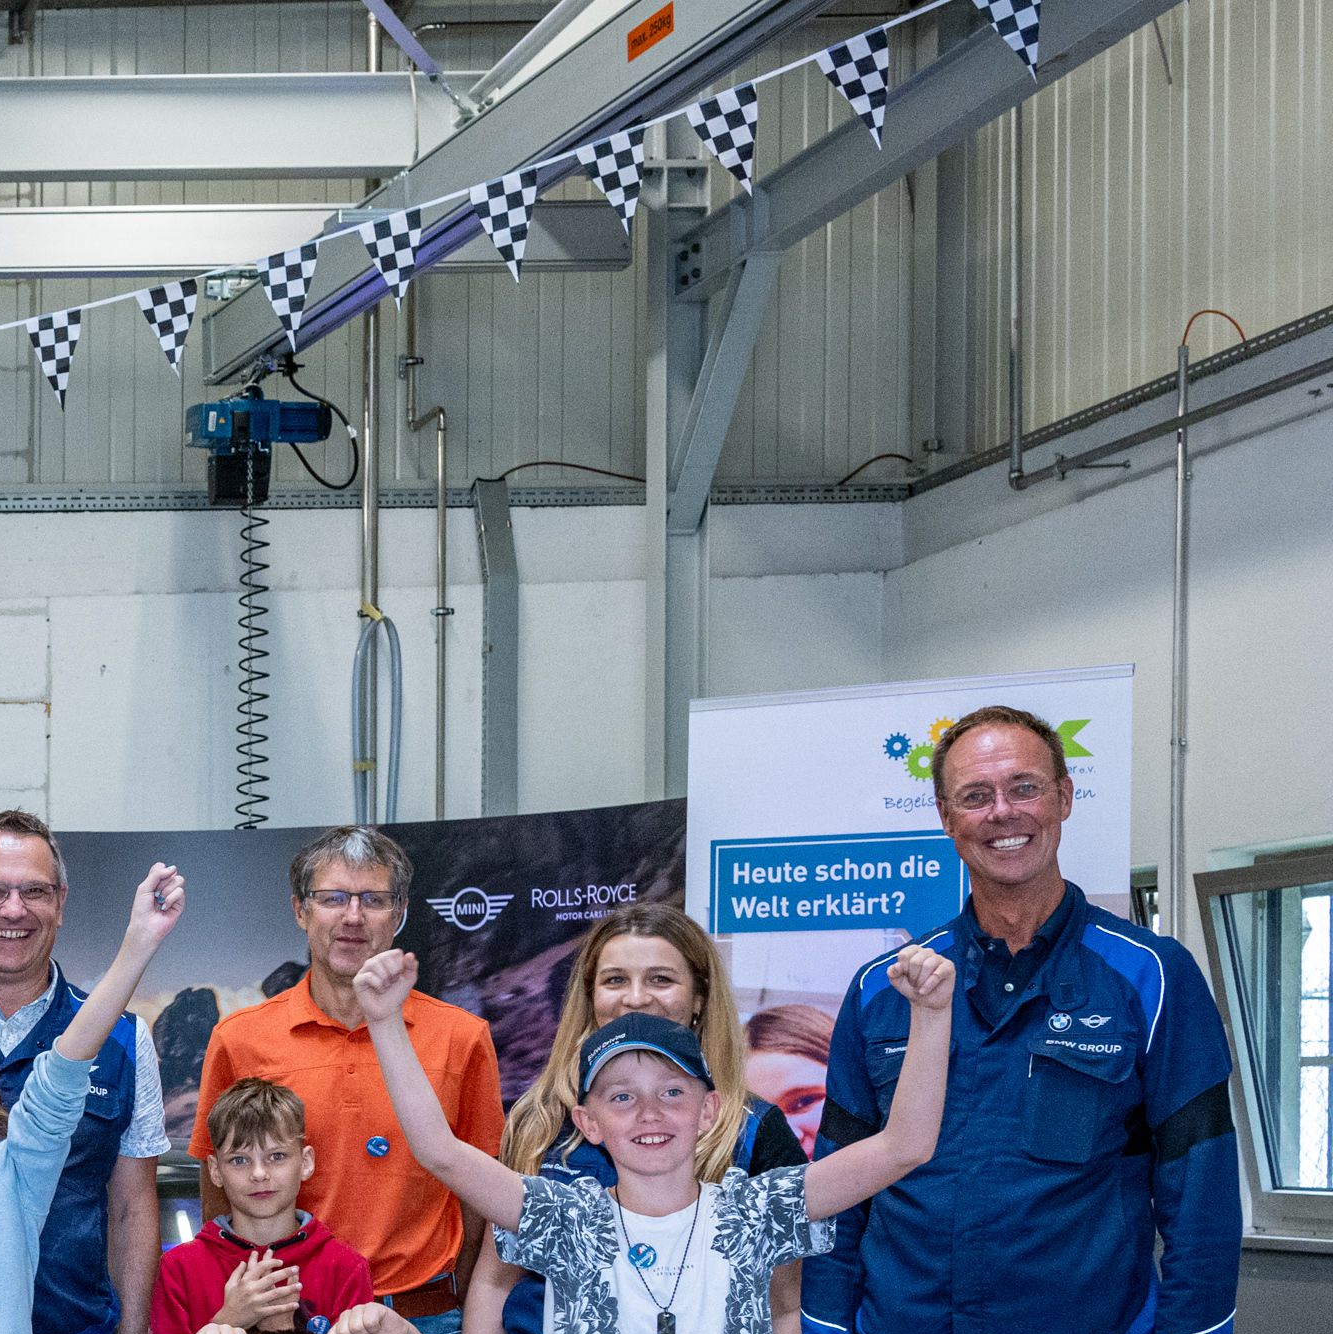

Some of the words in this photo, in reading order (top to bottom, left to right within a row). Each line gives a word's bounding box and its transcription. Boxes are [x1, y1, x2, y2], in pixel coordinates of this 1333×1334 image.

[883, 793, 936, 813] Begeis
[732, 861, 808, 885] Heute
[814, 857, 893, 882] schon
[899, 855, 941, 879] die
[531, 883, 637, 908] ROLLS-ROYCE
[456, 903, 485, 916] MINI
[731, 895, 790, 919] Welt
[796, 891, 906, 917] erklärt?
[555, 911, 584, 921] MOTOR
[584, 909, 604, 919] CARS
[1077, 1043, 1122, 1054] GROUP
[89, 1086, 108, 1096] OUP
